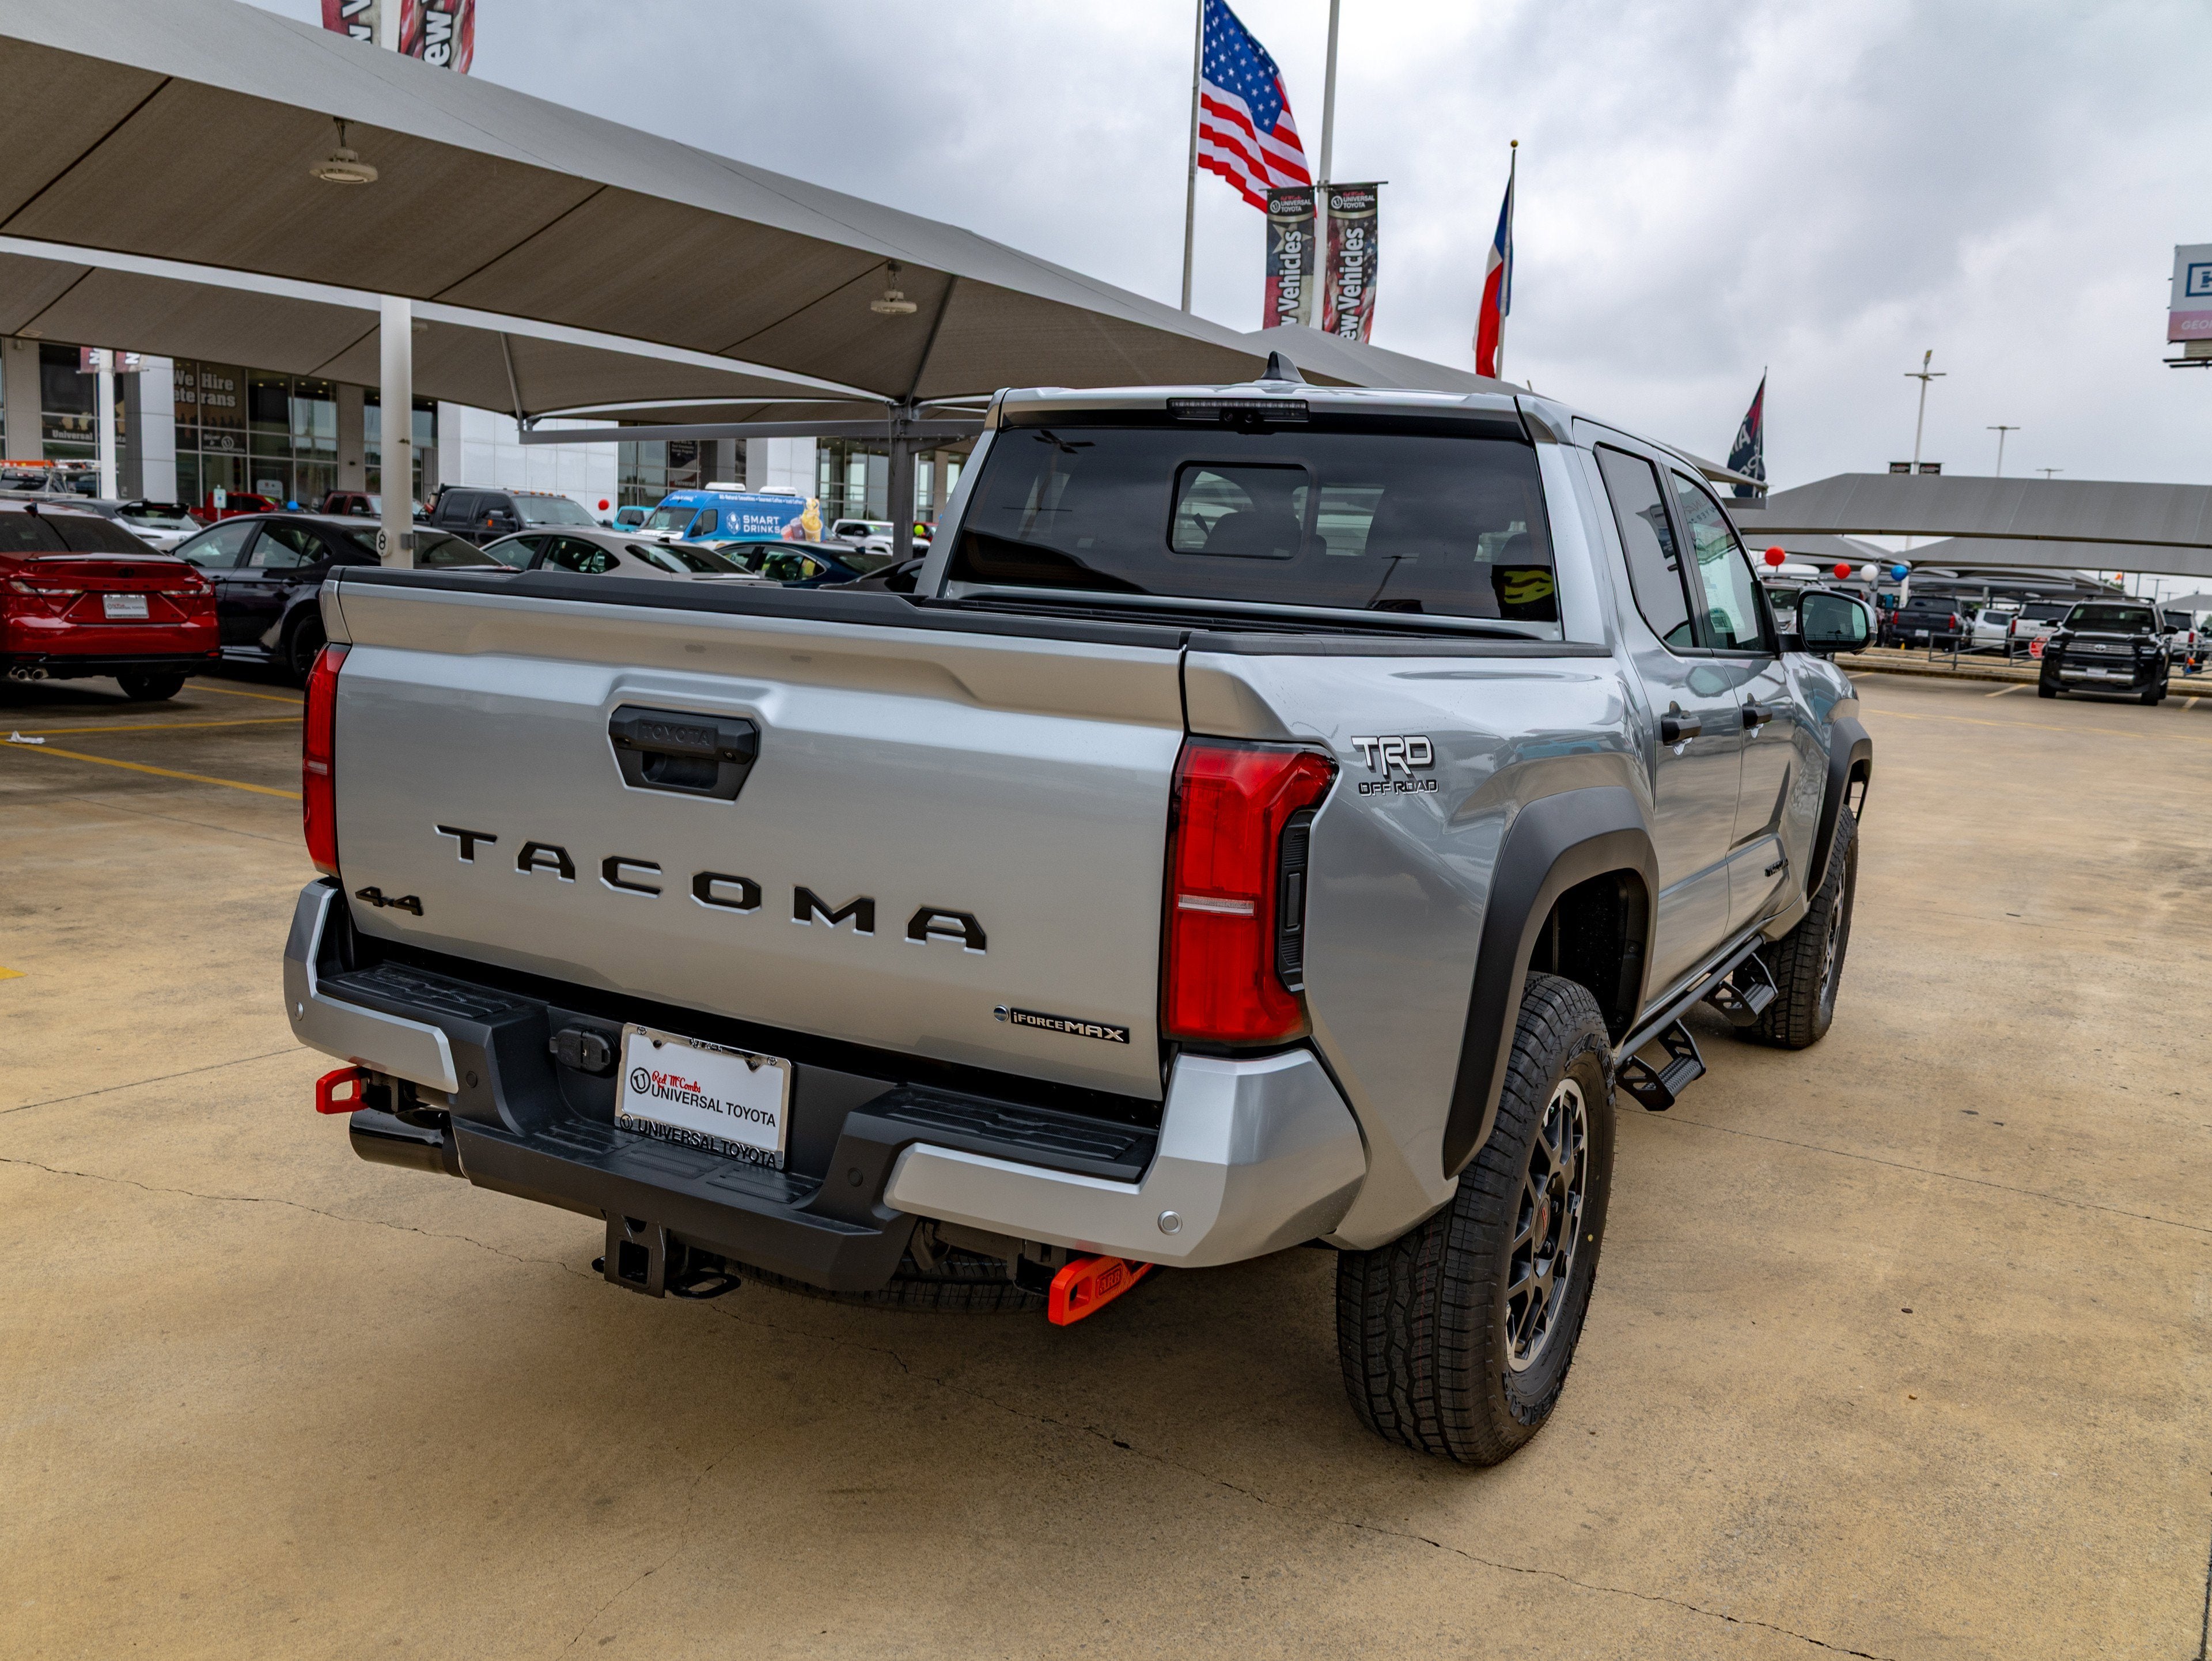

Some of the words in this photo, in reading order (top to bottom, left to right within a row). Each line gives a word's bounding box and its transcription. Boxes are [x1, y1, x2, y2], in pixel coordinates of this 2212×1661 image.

[1277, 230, 1302, 312] Vehicles
[1338, 227, 1365, 311] Vehicles
[202, 373, 234, 391] Hire
[52, 429, 93, 441] Universal
[743, 514, 779, 524] SMART
[744, 524, 781, 534] DRINKS
[378, 534, 386, 550] 8
[641, 722, 711, 746] TOYOTA
[1350, 735, 1434, 778] TRD
[1358, 781, 1391, 797] OFF
[1393, 779, 1439, 795] ROAD
[434, 824, 987, 955] TACOMA
[652, 1070, 667, 1088] Red
[668, 1074, 701, 1094] McCombs
[652, 1084, 724, 1114] UNIVERSAL
[726, 1102, 777, 1127] TOYOTA
[638, 1119, 719, 1152] UNIVERSAL
[721, 1138, 777, 1168] TOYOTA
[1099, 1270, 1120, 1293] ARB
